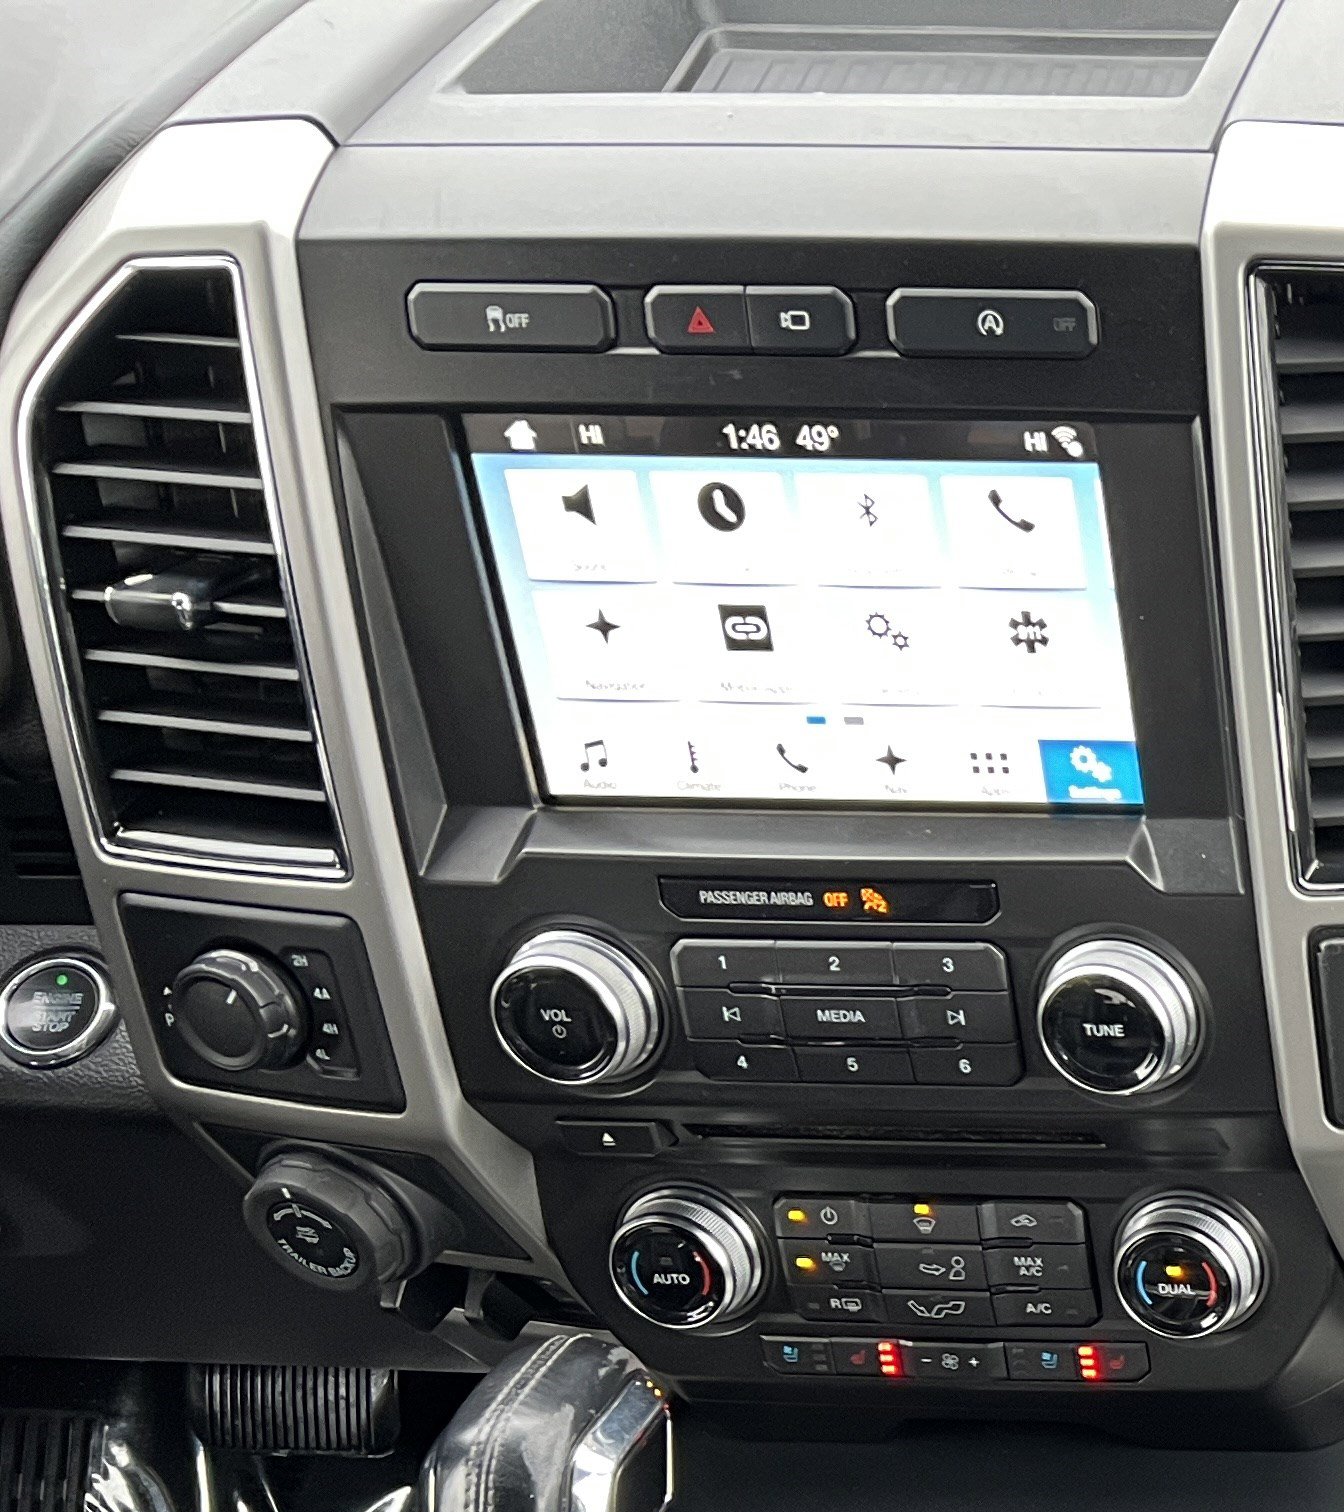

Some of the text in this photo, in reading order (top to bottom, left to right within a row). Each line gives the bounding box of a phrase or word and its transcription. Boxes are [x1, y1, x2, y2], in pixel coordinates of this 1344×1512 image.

[505, 312, 530, 329] OFF
[578, 424, 605, 447] HI
[721, 423, 781, 452] 1:46
[1023, 430, 1049, 453] HI
[699, 890, 849, 908] PASSENGER AIRBAG OFF
[718, 955, 728, 971] 1
[828, 956, 841, 972] 2
[942, 957, 955, 973] 3
[540, 1008, 573, 1023] VOL
[816, 1009, 866, 1024] MEDIA
[31, 1021, 70, 1033] STOP
[1082, 1022, 1125, 1038] TUNE
[737, 1055, 748, 1070] 4
[846, 1057, 859, 1072] 5
[959, 1059, 972, 1075] 6
[821, 1252, 851, 1264] MAX
[1013, 1256, 1044, 1269] MAX
[1018, 1265, 1044, 1278] A/C
[653, 1273, 691, 1286] AUTO
[1157, 1282, 1196, 1296] DUAL
[1026, 1302, 1052, 1315] A/C
